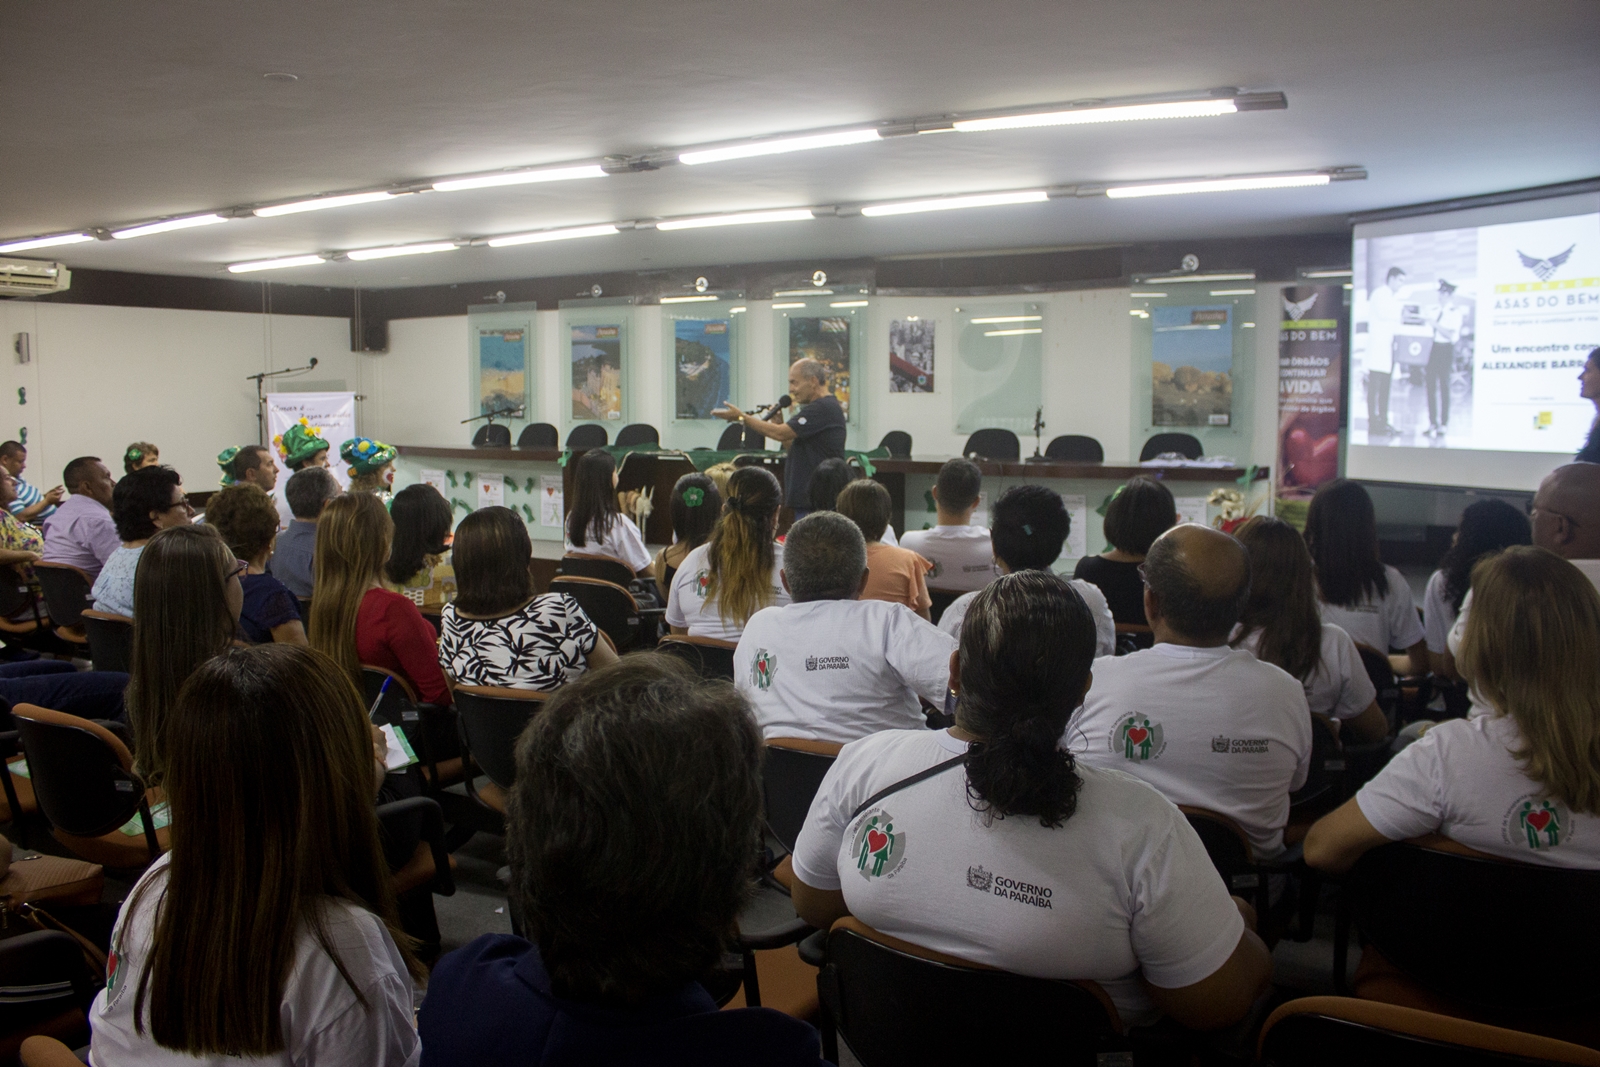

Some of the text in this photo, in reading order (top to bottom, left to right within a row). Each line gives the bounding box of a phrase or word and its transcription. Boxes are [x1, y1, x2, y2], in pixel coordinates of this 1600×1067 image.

[1495, 292, 1600, 309] ASAS DO BEM
[1291, 330, 1307, 341] DO
[1310, 330, 1337, 341] BEM
[1491, 345, 1512, 354] Um
[1515, 344, 1570, 353] encontro
[1482, 360, 1586, 370] ALEXANDRE BARR
[1286, 380, 1324, 394] VIDA
[1231, 739, 1269, 747] GOVERNO
[1231, 746, 1241, 754] DA
[995, 876, 1053, 898] GOVERNO
[994, 886, 1053, 910] DA PARAÍBA
